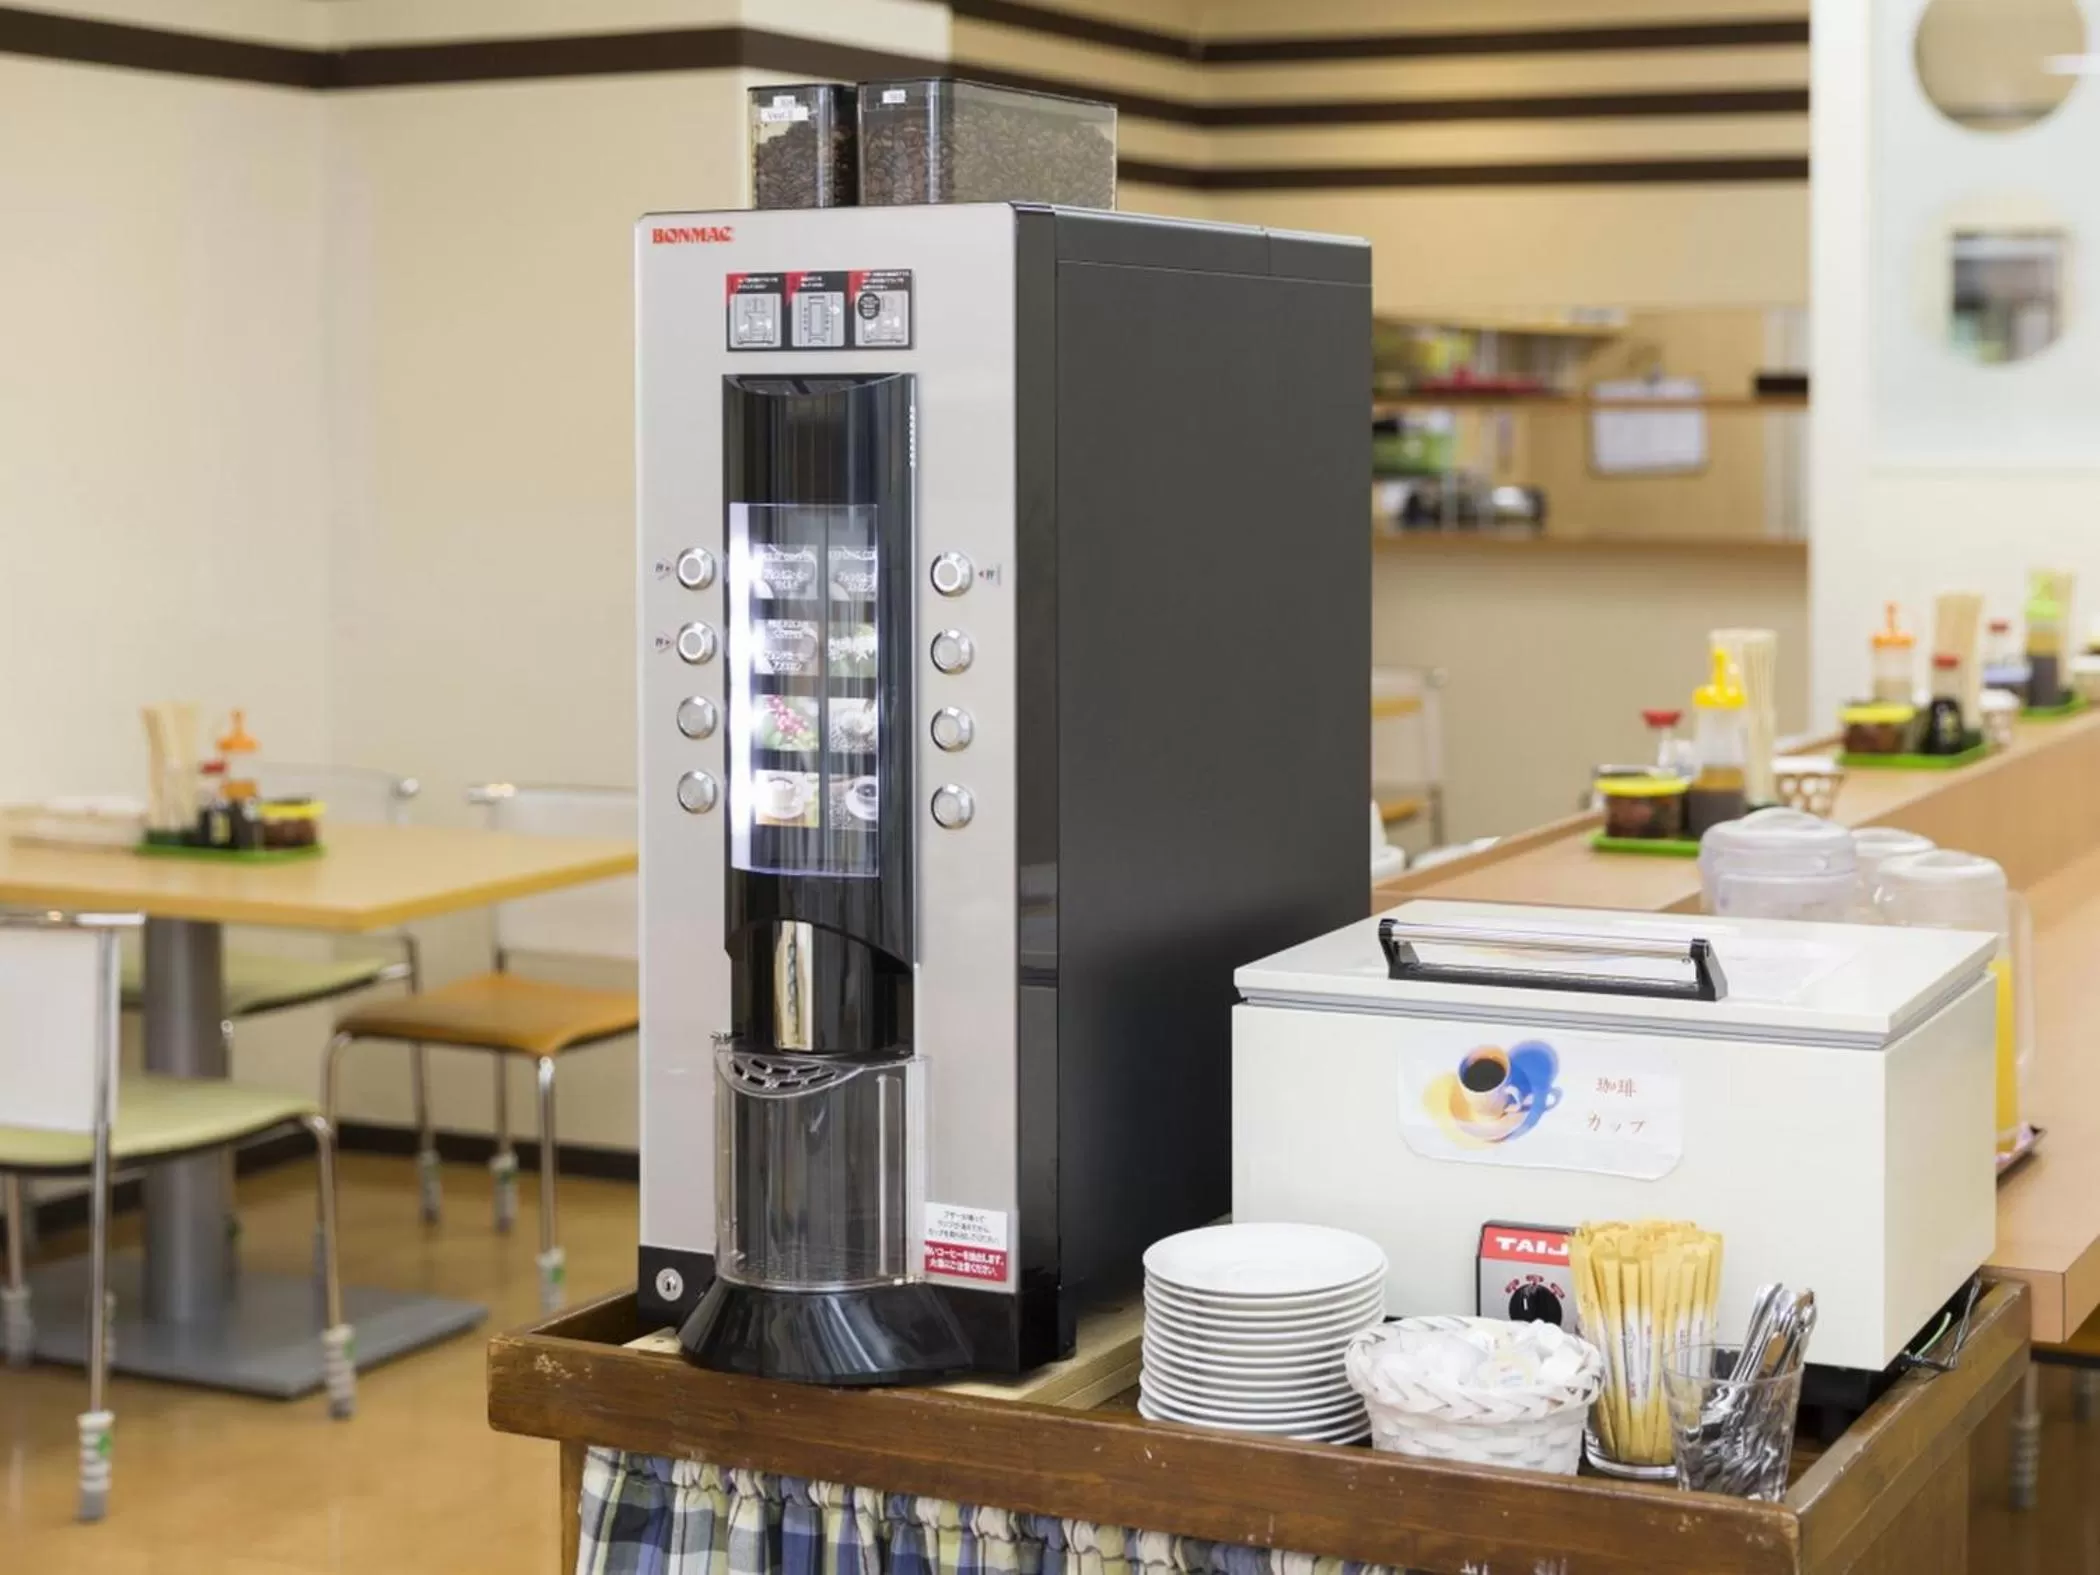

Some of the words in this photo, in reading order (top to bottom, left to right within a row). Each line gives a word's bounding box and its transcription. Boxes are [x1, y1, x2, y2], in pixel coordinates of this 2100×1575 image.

[652, 226, 734, 244] BONMAC
[1595, 1077, 1637, 1097] 珈琲
[1588, 1111, 1647, 1133] カップ
[1496, 1236, 1569, 1256] TAIJ
